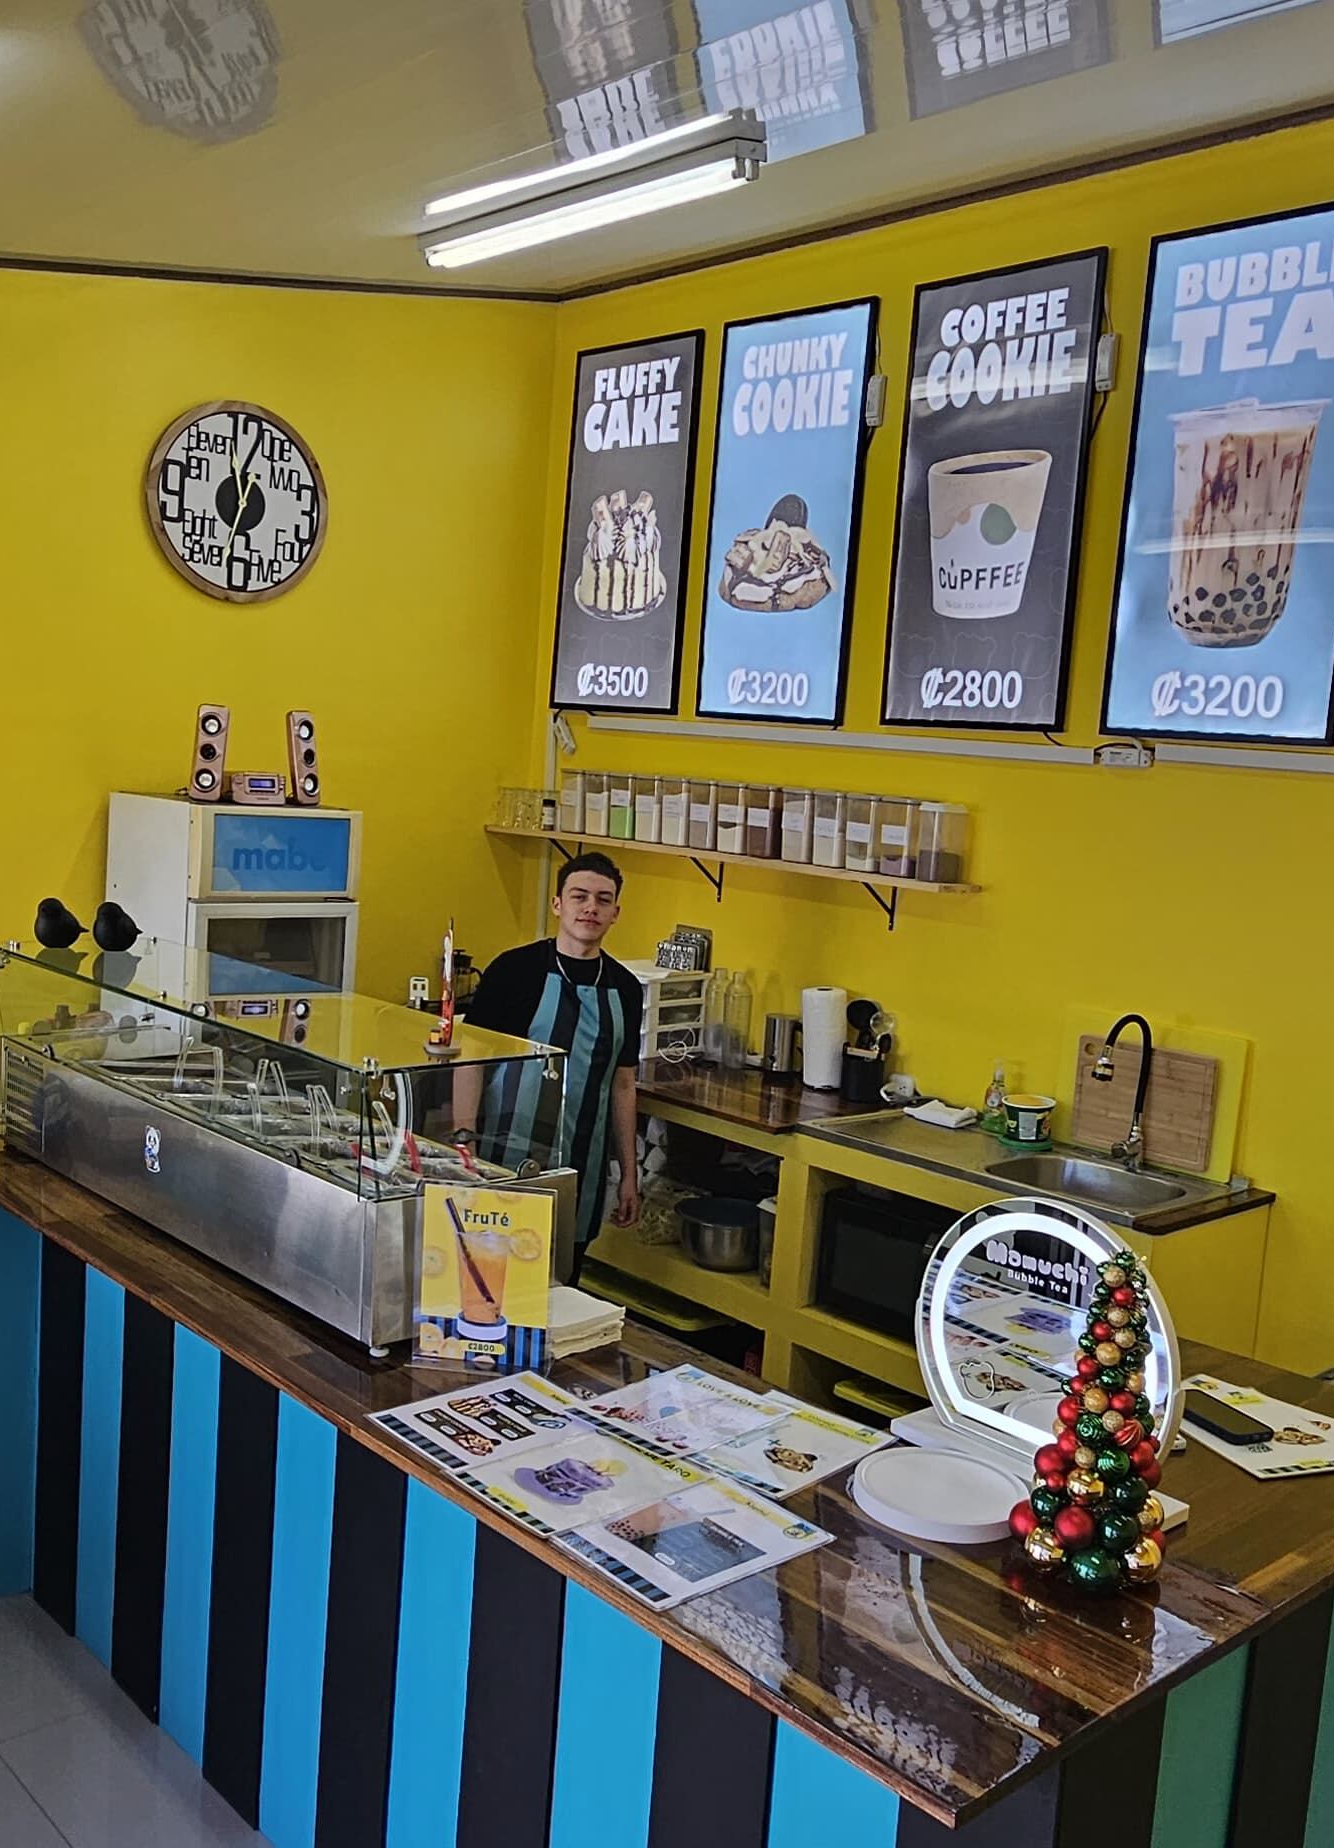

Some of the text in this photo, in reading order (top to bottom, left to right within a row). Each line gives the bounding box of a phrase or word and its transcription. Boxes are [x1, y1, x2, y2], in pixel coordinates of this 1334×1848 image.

[940, 286, 1070, 348] COFFEE
[594, 355, 681, 402] FLUFFY
[743, 332, 849, 379] CHUNKY
[926, 328, 1077, 412] COOKIE
[584, 391, 683, 453] CAKE
[733, 369, 854, 437] COOKIE
[294, 485, 316, 544] 3
[464, 1208, 509, 1227] FruTé
[1007, 1268, 1068, 1294] Bubble Tea
